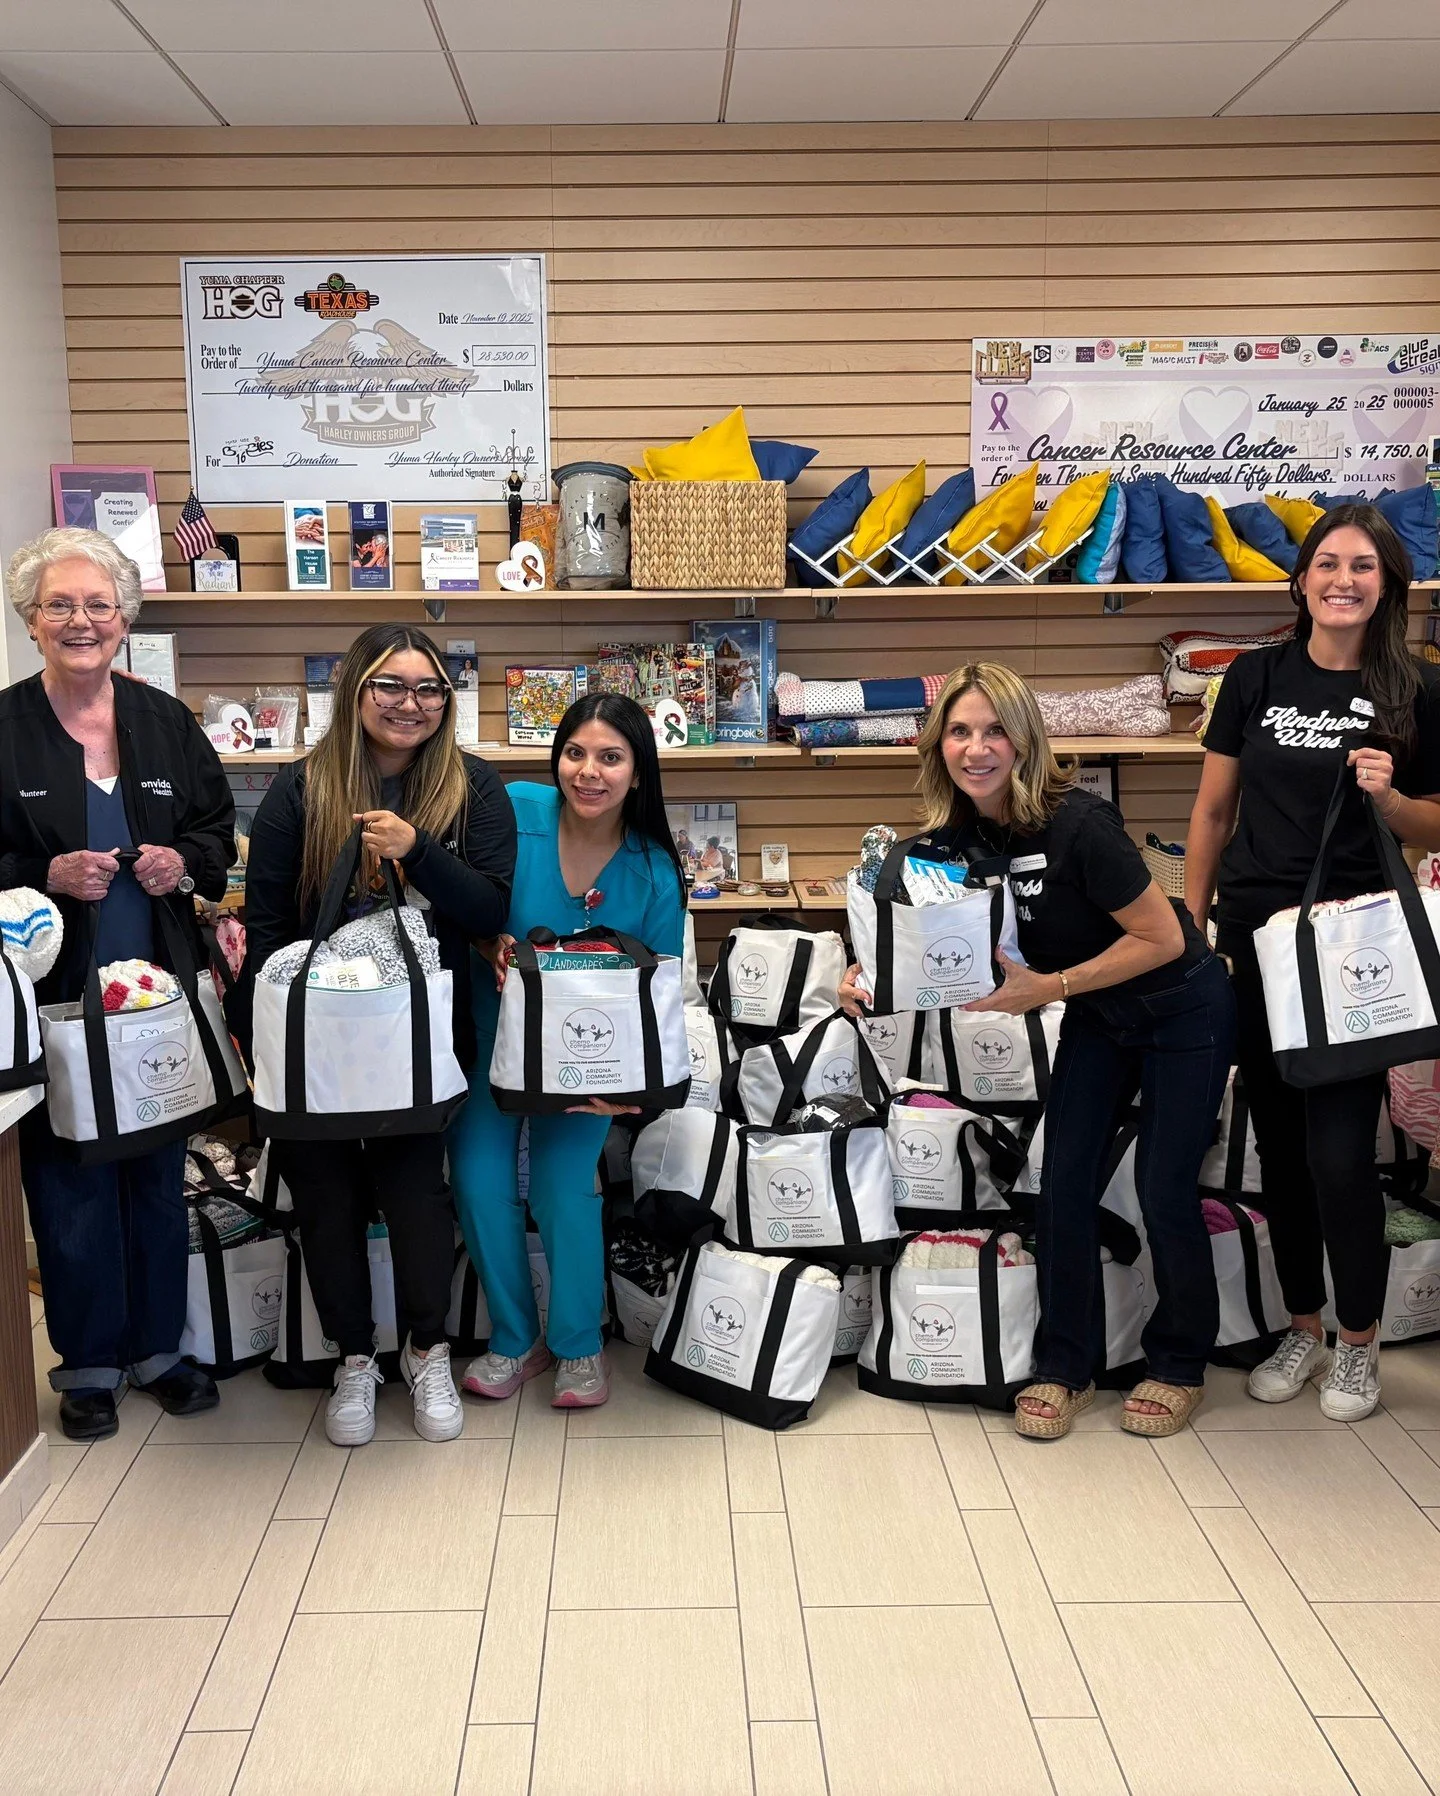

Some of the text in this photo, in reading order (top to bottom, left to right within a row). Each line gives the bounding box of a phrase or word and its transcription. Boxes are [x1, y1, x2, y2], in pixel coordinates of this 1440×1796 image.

[199, 275, 285, 285] YUMA CHAPTER
[201, 285, 284, 319] HOG
[307, 292, 369, 309] TEXAS
[439, 312, 459, 324] Date
[462, 313, 496, 323] November
[508, 313, 532, 322] 2025
[201, 344, 242, 358] Pay to the
[1374, 345, 1390, 353] ACS
[1399, 338, 1429, 358] Blue
[256, 350, 448, 374] Yuma Cancer Resource Center
[463, 348, 470, 364] $
[201, 357, 238, 369] Order of
[234, 378, 534, 400] Twenty eight thousand five hundred thirty Dollars
[1258, 393, 1389, 418] January 25 20 25
[1393, 398, 1434, 409] 000005
[324, 427, 415, 442] HARLEY OWNERS GROUP
[981, 443, 1021, 454] Pay to the
[1026, 432, 1299, 461] Cancer Resource Center
[1344, 446, 1352, 459] $
[205, 451, 340, 468] For Donation
[388, 450, 421, 468] Yuma
[423, 451, 461, 467] Harley
[981, 454, 1014, 462] order of
[428, 468, 496, 479] Authorized Signature
[1170, 462, 1232, 484] Hundred
[1234, 462, 1273, 491] Fifty
[1275, 462, 1333, 483] Dollars.
[1344, 473, 1396, 482] DOLLARS
[104, 498, 134, 507] Creating
[108, 508, 138, 516] Renewed
[583, 511, 606, 530] M
[502, 571, 521, 581] LOVE
[1260, 706, 1370, 731] Kindness
[211, 733, 231, 743] HOPE
[152, 788, 174, 797] Health
[549, 959, 604, 970] LANDSCAPES
[1371, 1003, 1398, 1014] ARIZONA
[1372, 1007, 1410, 1020] COMMUNITY
[1374, 1012, 1413, 1026] FOUNDATION
